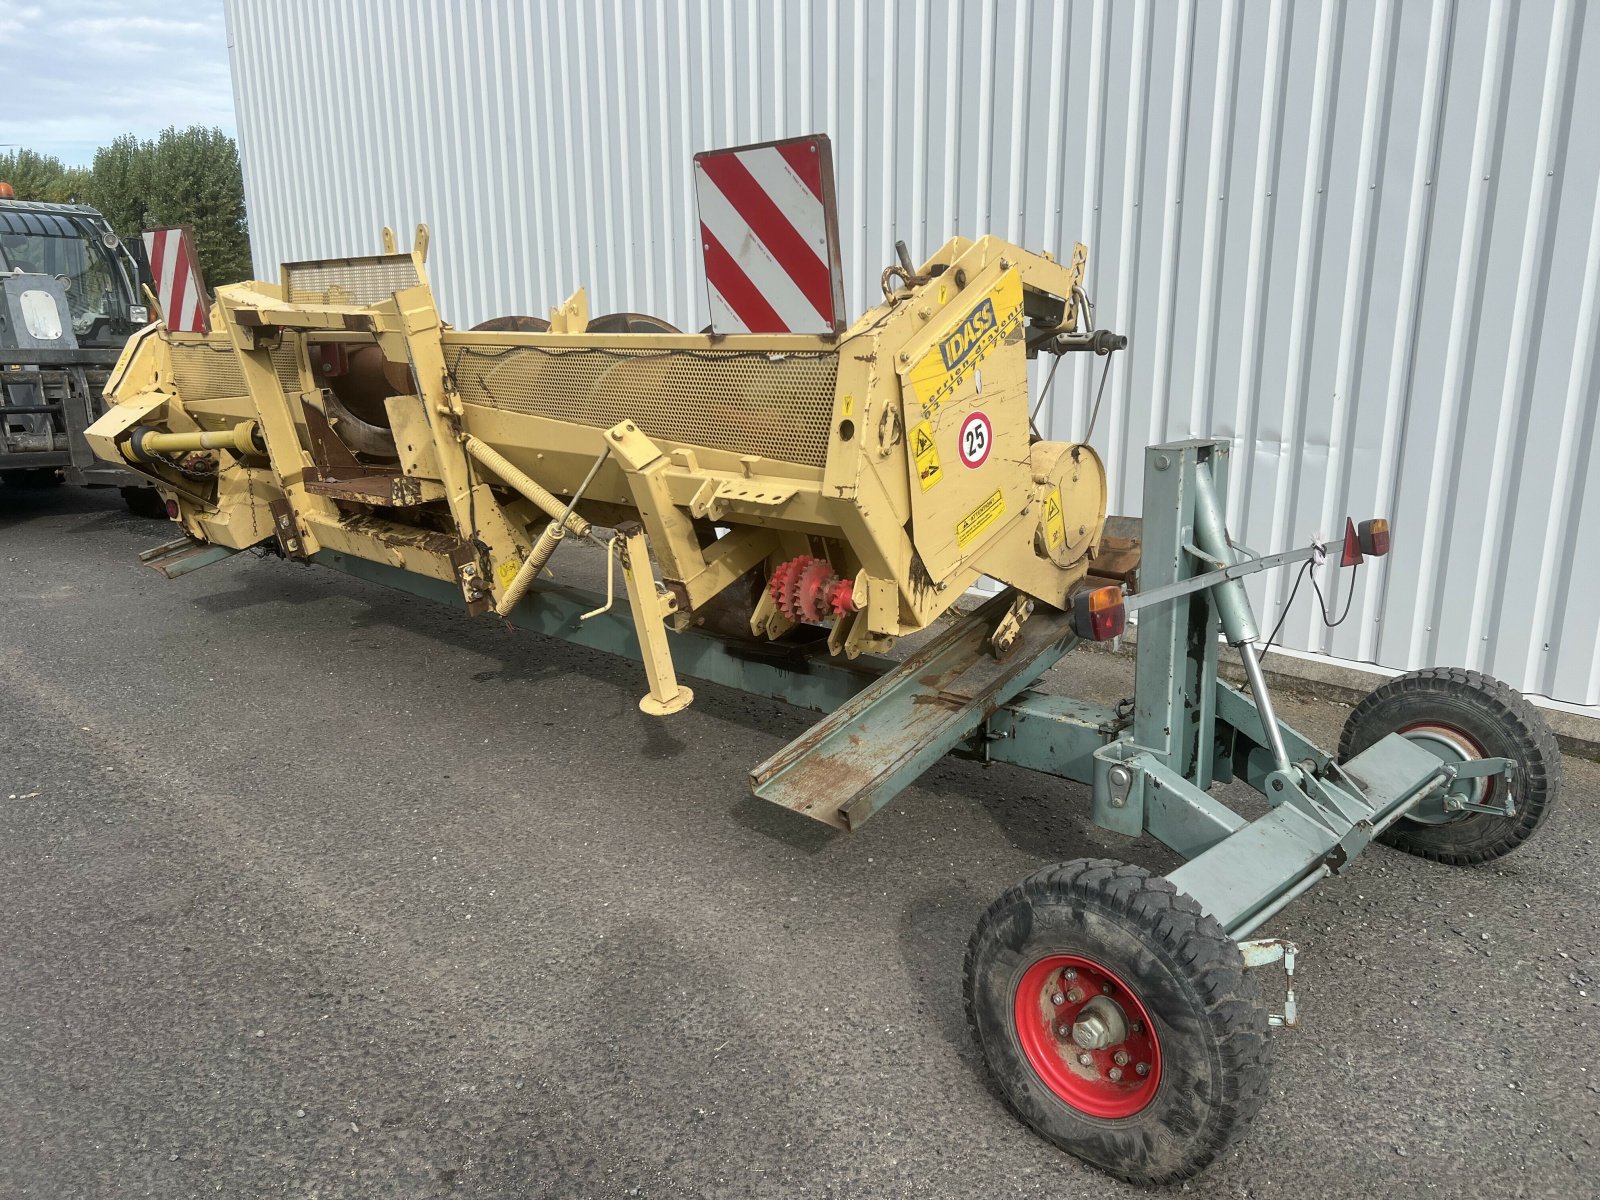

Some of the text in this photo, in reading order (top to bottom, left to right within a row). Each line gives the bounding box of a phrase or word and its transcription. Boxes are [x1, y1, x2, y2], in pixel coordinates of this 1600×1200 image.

[944, 302, 993, 367] IDASS
[922, 360, 969, 409] terrien
[924, 402, 940, 419] 02
[948, 377, 963, 395] 38
[971, 354, 985, 371] 74
[992, 331, 1006, 349] 70
[966, 423, 984, 457] 25
